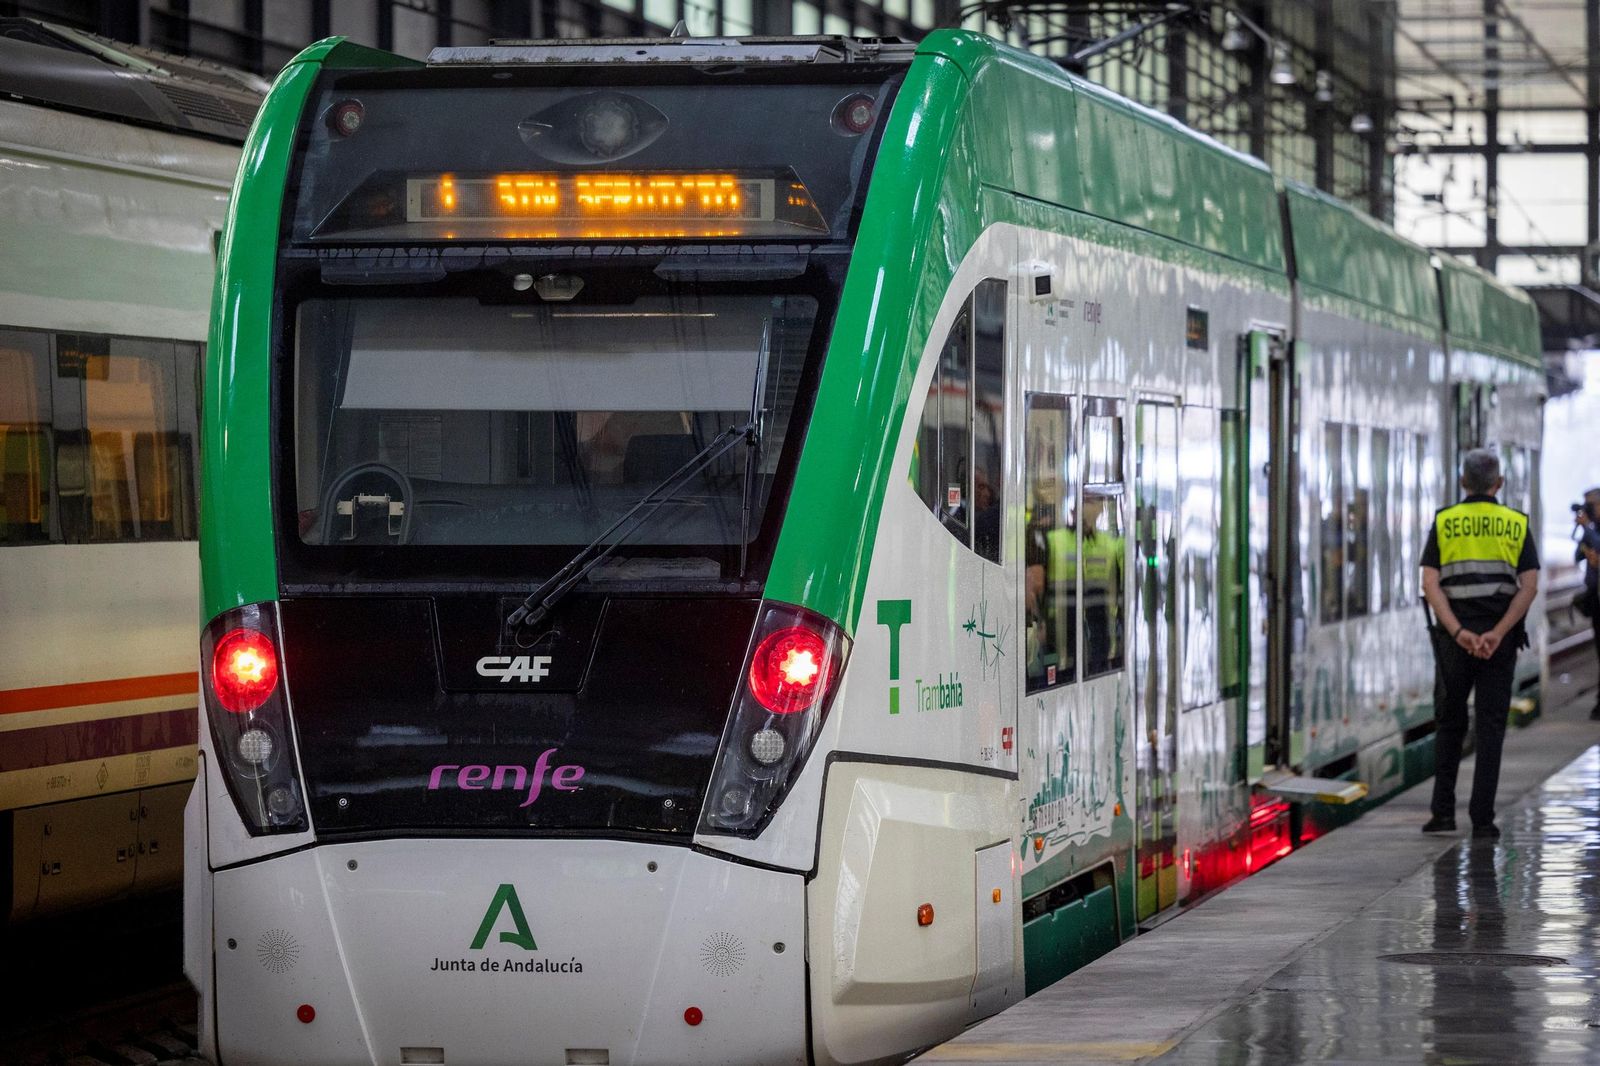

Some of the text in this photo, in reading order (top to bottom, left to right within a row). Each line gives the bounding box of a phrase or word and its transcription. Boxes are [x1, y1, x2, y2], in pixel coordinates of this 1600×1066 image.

[1444, 516, 1522, 541] SEGURIDAD
[475, 656, 552, 683] CAF
[915, 671, 963, 713] Trambahía
[427, 748, 586, 808] renfe
[430, 957, 583, 973] Junta de Andalucía
